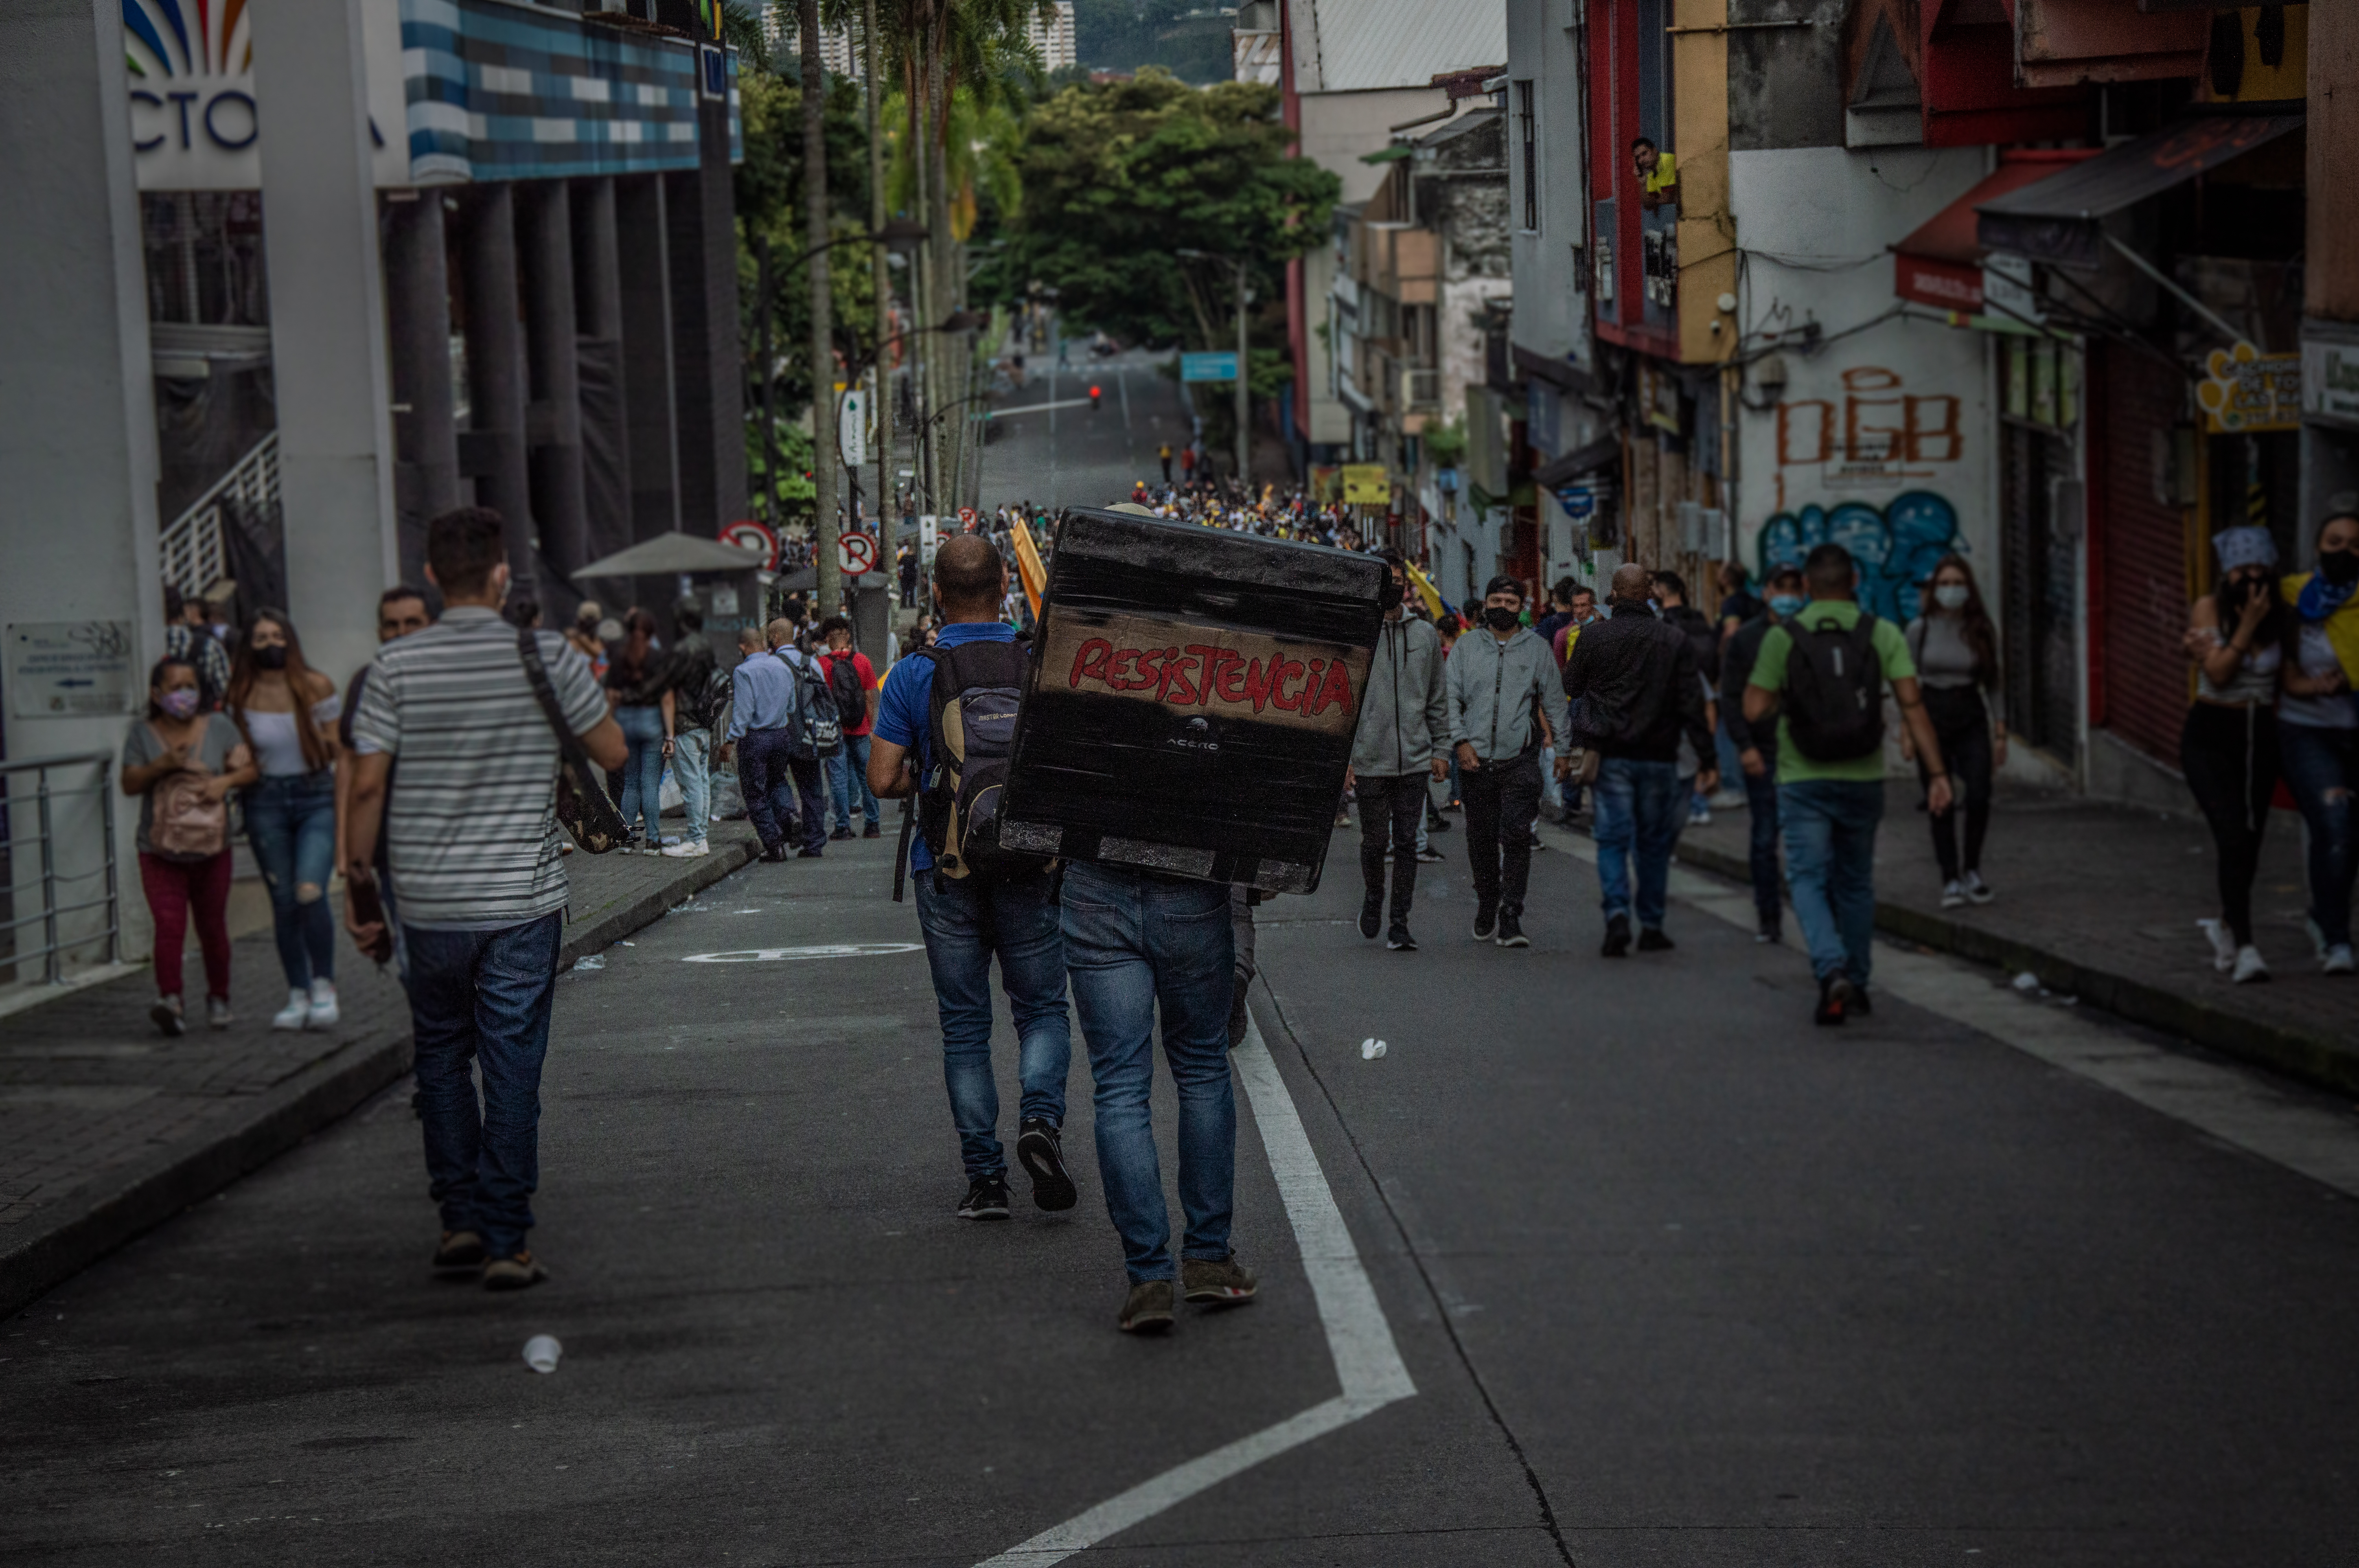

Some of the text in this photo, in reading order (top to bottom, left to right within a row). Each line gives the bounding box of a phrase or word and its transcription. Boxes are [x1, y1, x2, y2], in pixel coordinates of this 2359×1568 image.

[2220, 359, 2300, 377] CACHOR
[2239, 377, 2263, 392] DE
[2234, 393, 2269, 409] LAS
[1069, 637, 1355, 717] RESISTENCIA
[979, 713, 999, 721] MASTER
